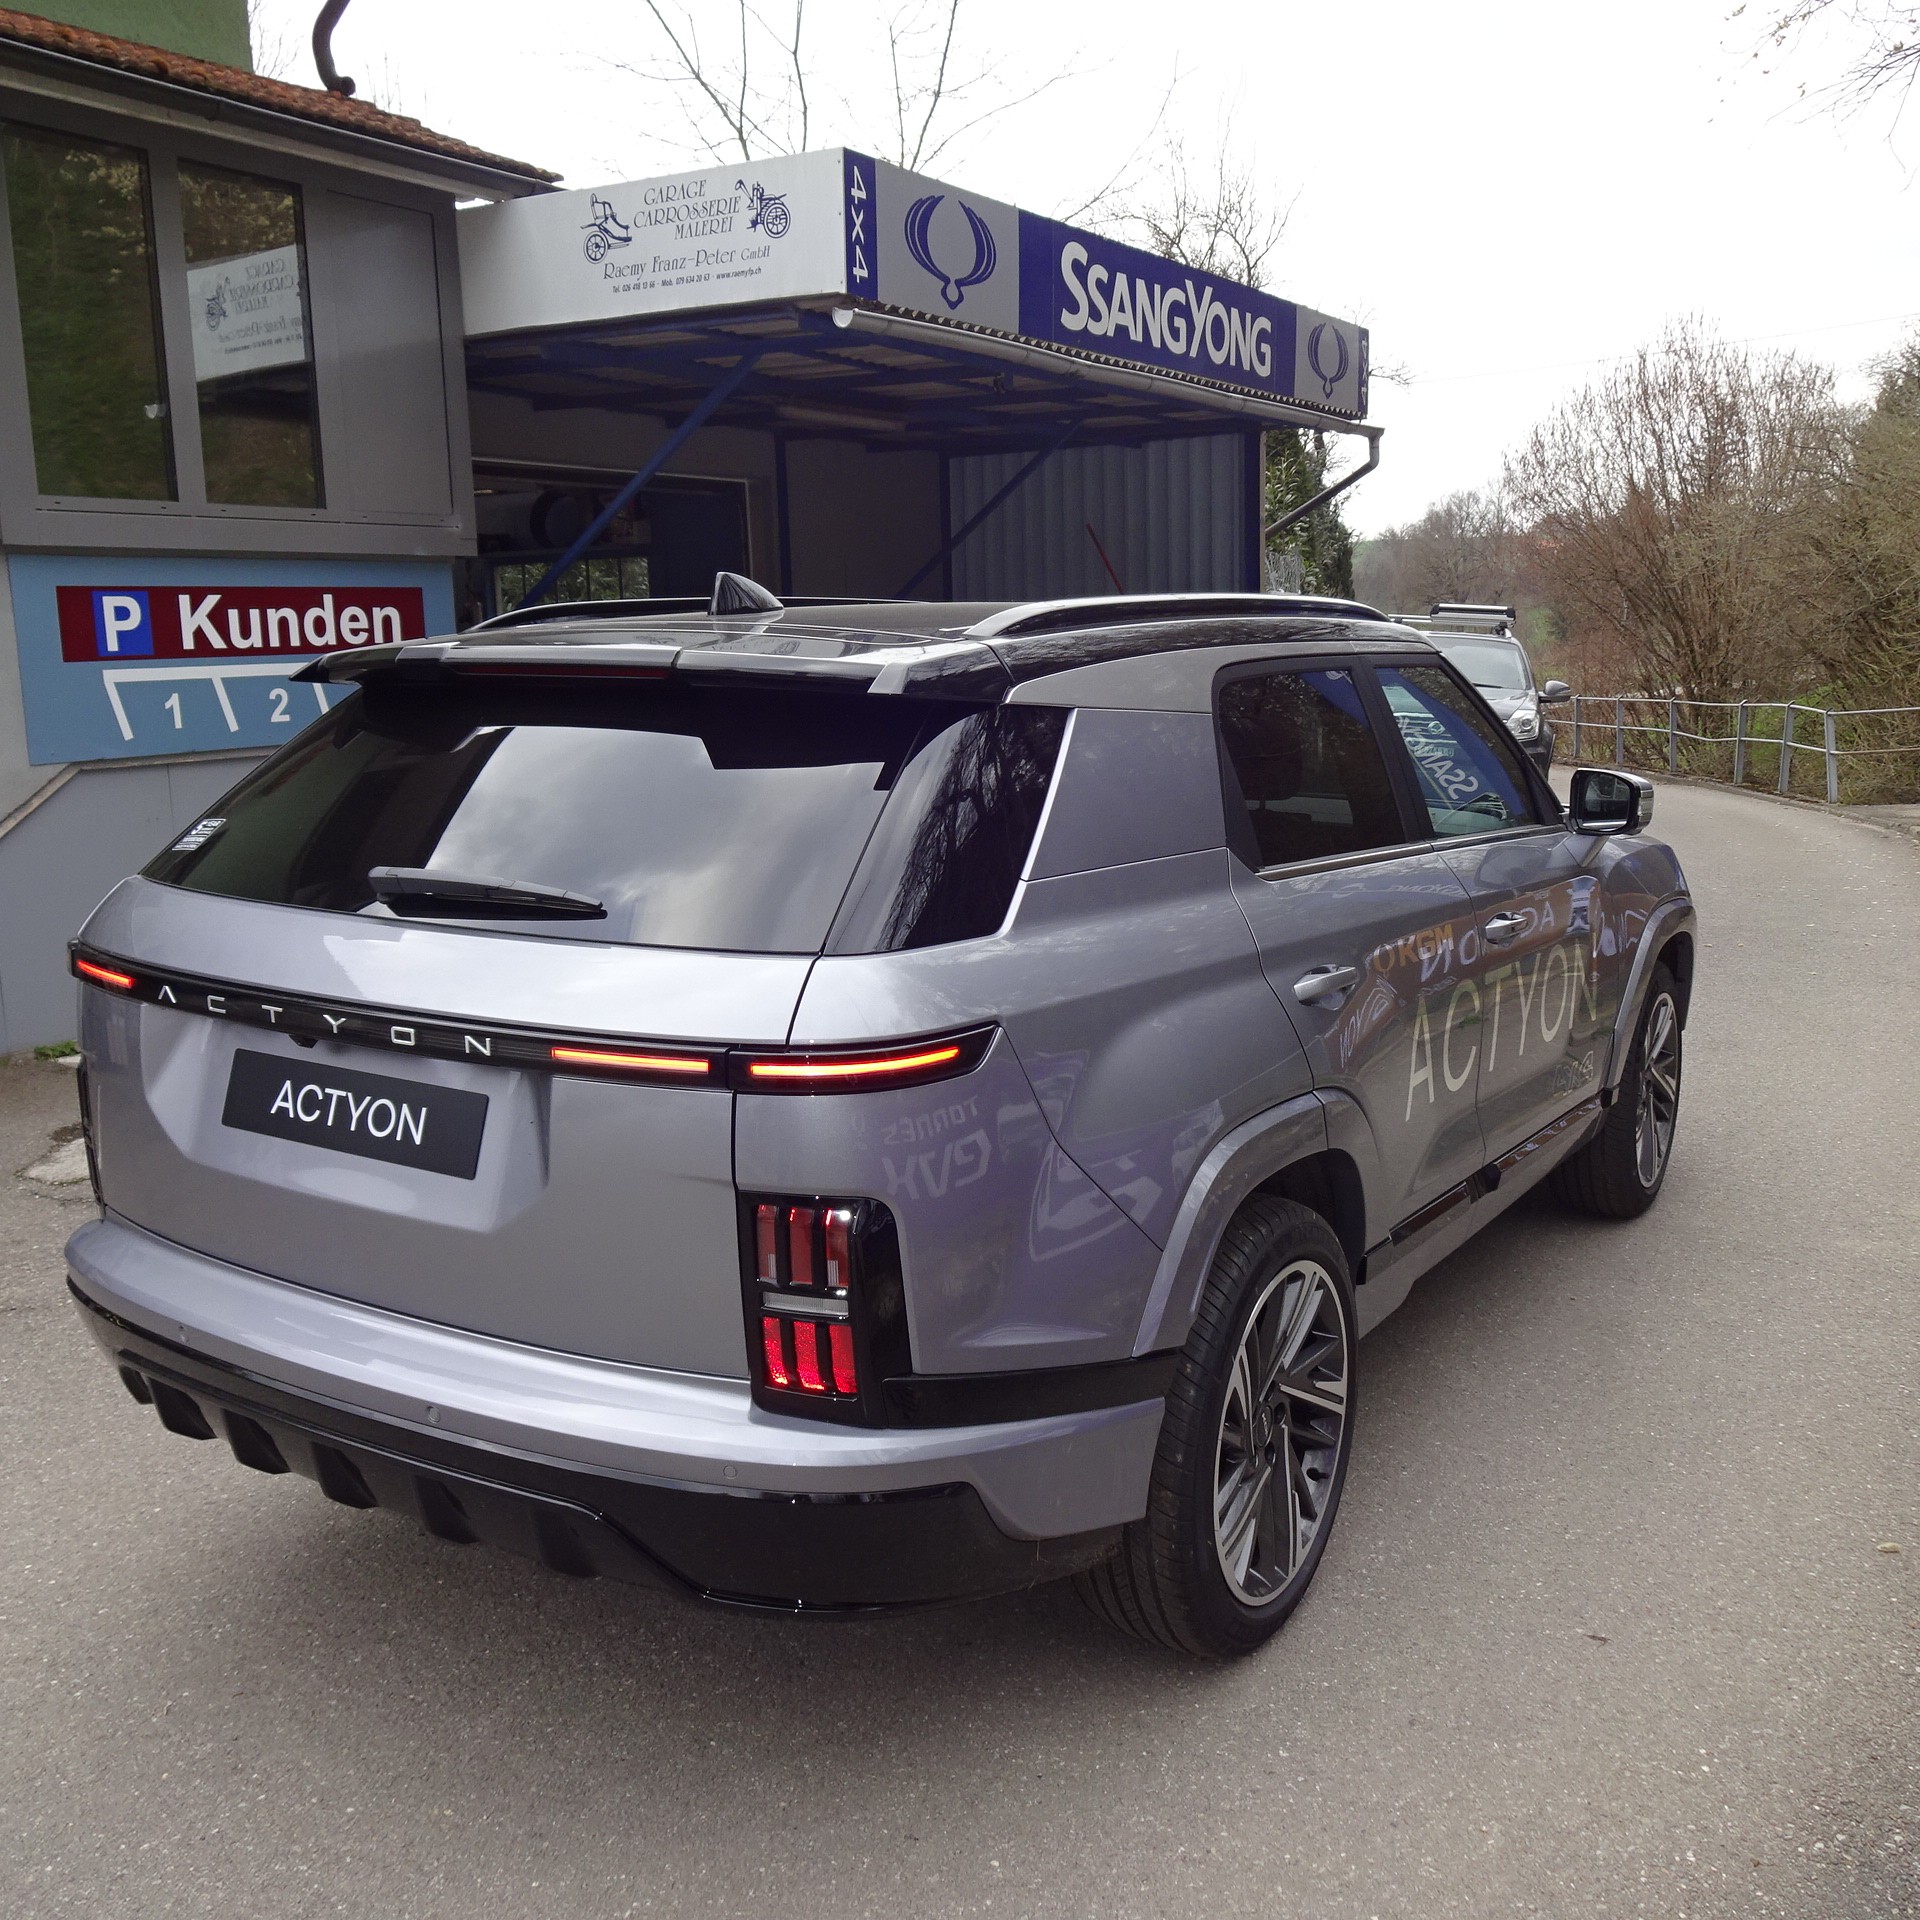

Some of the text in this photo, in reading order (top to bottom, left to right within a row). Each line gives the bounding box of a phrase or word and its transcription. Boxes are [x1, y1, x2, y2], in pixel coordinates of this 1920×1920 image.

[633, 195, 741, 229] CARROSSERIE
[643, 179, 707, 206] GARAGE
[674, 215, 734, 240] MALEREI
[603, 245, 771, 281] Raemy Franz-Peter GmbH
[102, 593, 401, 652] P Kunden
[163, 688, 291, 729] 1 2
[158, 984, 493, 1057] ACTYON
[1405, 937, 1597, 1123] ACTYON
[270, 1079, 428, 1146] ACTYON
